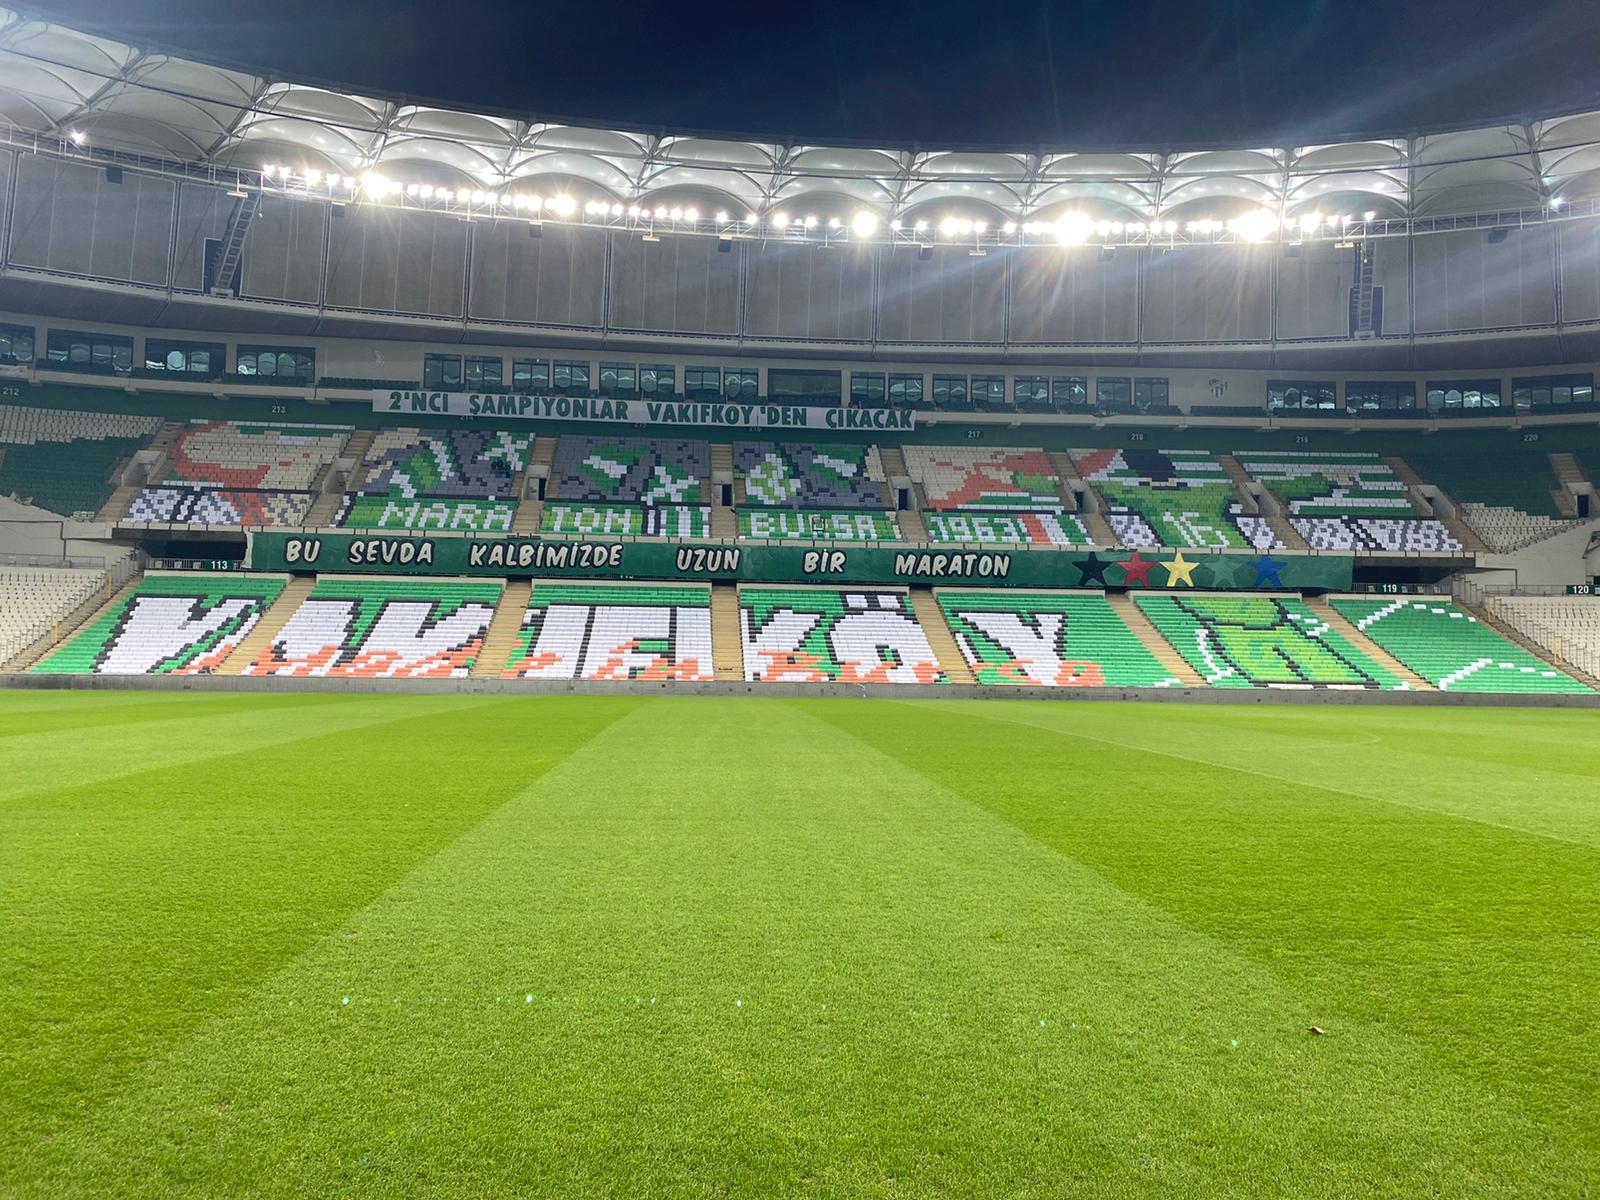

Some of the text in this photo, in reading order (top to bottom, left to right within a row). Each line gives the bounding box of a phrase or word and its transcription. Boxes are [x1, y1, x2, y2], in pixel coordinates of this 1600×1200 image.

[3, 386, 20, 396] 212
[271, 405, 286, 414] 213
[967, 430, 981, 439] 217
[285, 540, 1011, 578] BU SEVDA KALBİMİZDE UZUN BİR MARATON
[211, 560, 228, 570] 113
[1382, 584, 1398, 593] 119
[1572, 585, 1590, 594] 120
